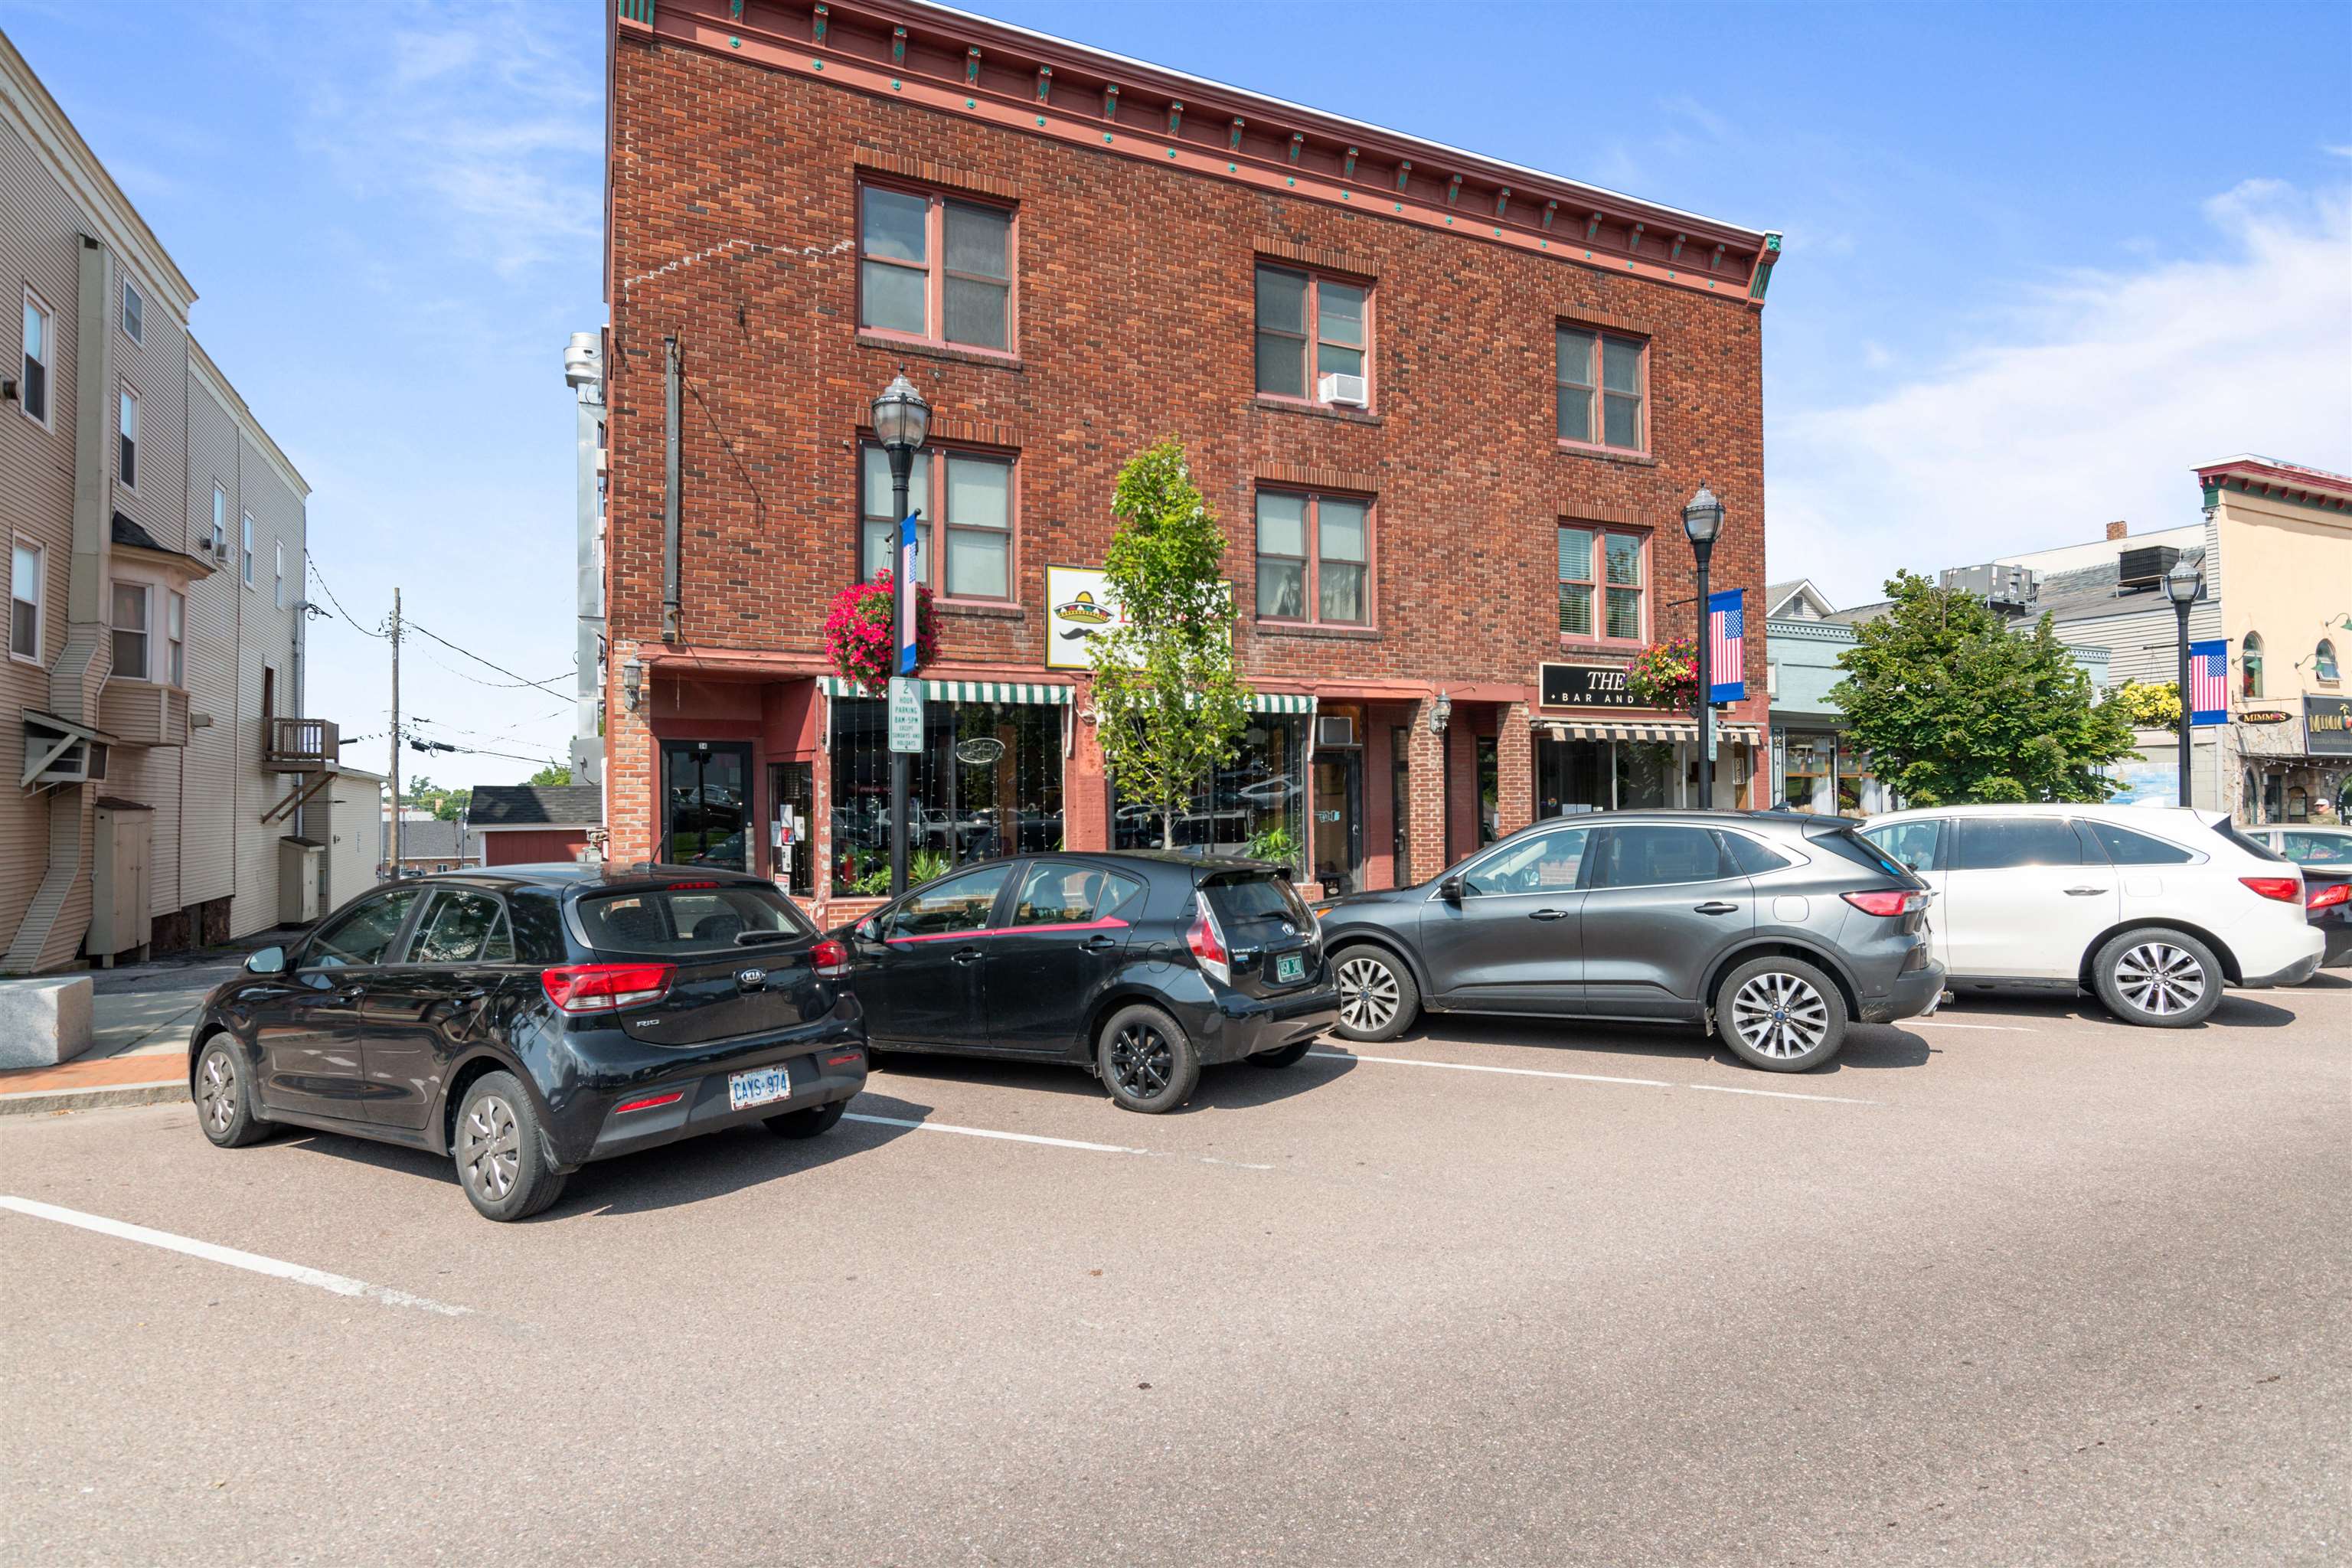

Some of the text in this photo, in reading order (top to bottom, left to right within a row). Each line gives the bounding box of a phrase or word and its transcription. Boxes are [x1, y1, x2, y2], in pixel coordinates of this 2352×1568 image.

[1587, 671, 1625, 691] THE
[903, 683, 908, 694] 2
[1562, 693, 1634, 704] BAR AND
[746, 972, 760, 981] KIA
[734, 1078, 762, 1100] CAYS
